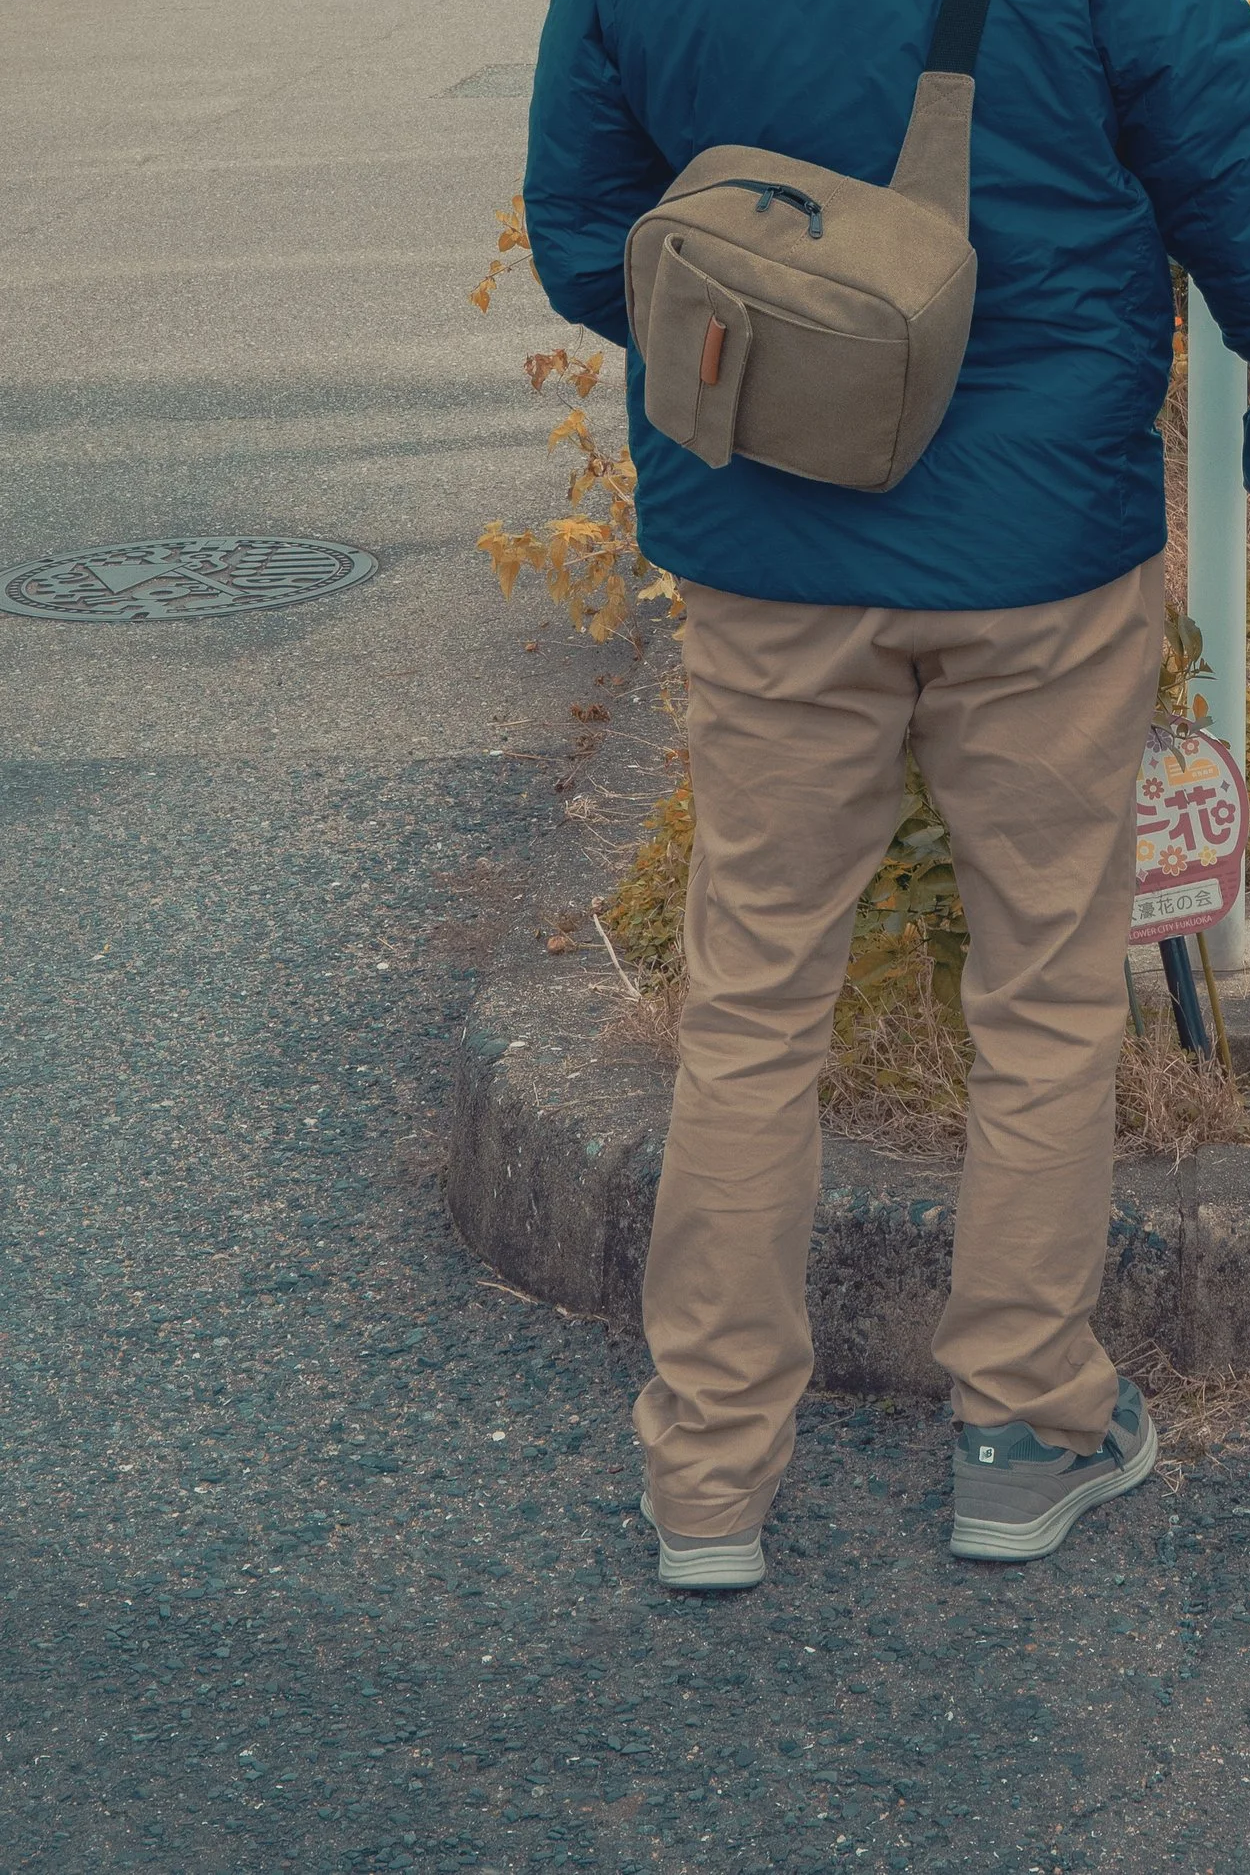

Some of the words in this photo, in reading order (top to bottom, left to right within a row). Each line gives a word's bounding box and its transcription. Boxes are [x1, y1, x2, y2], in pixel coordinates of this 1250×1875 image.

[1132, 890, 1213, 921] 濠花の会
[1128, 927, 1157, 940] LOWER
[1157, 923, 1175, 934] CITY
[1175, 915, 1213, 929] FUKUOKA
